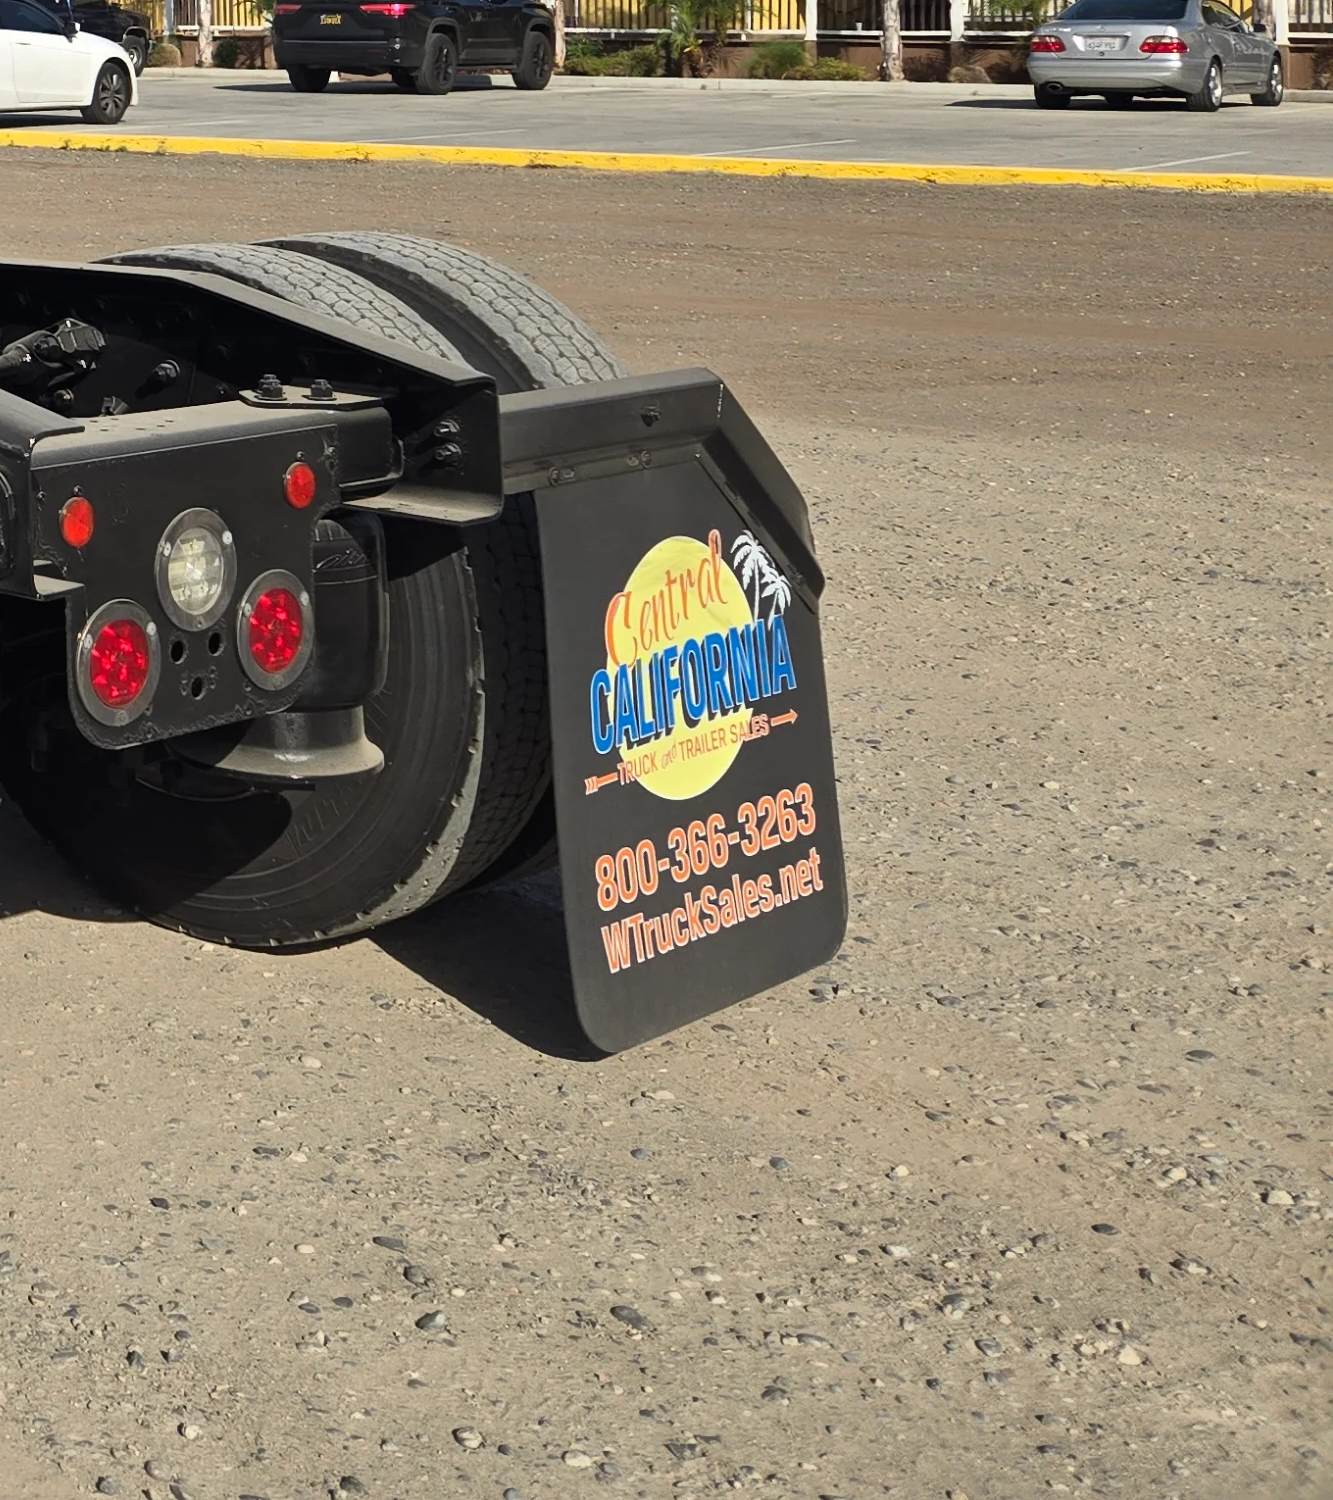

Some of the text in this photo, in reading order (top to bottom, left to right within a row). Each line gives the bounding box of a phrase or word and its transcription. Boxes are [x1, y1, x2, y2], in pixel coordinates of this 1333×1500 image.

[605, 529, 728, 668] Central
[590, 614, 797, 754] CALIFORNIA
[617, 713, 771, 785] TRUCK and TRAILER SALES
[595, 782, 816, 911] 800-366-3263
[600, 847, 824, 974] WTruckSales.net
